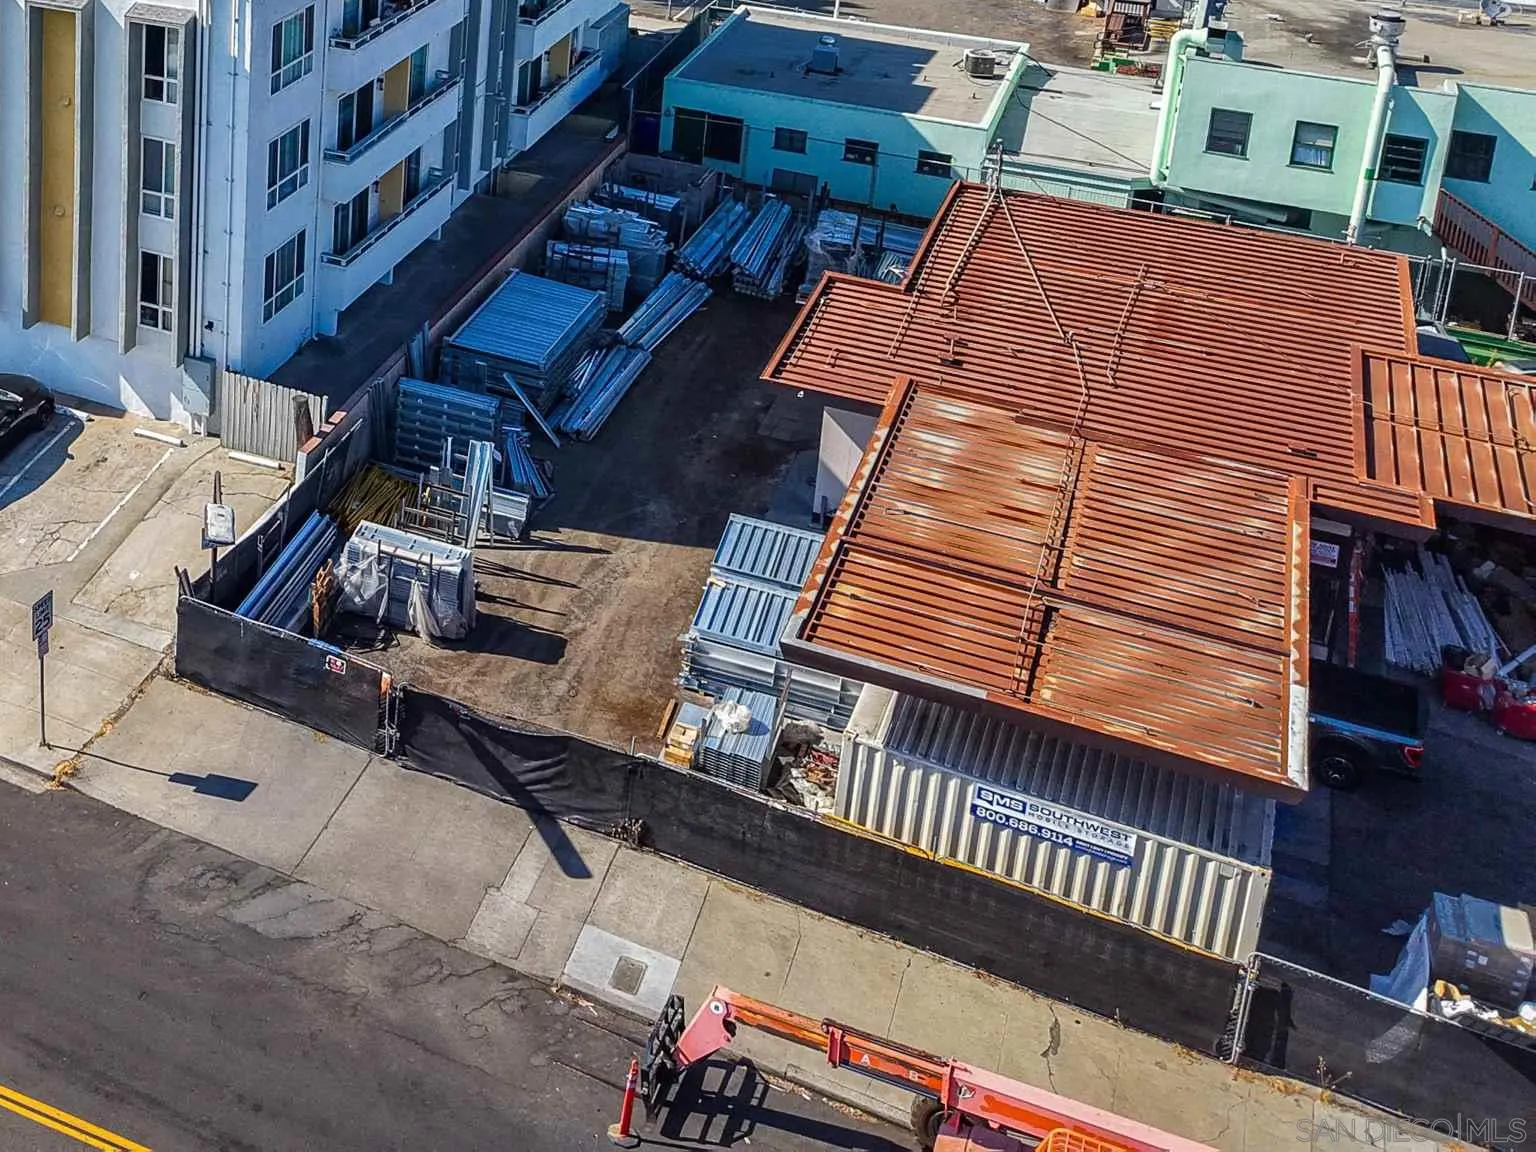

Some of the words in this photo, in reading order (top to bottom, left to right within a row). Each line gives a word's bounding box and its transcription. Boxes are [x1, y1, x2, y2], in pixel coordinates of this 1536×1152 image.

[35, 612, 50, 635] 25
[980, 790, 1024, 811] SMS
[976, 807, 1074, 847] 800.686.9114
[1029, 804, 1133, 841] SOUTHWEST
[860, 1053, 871, 1066] A
